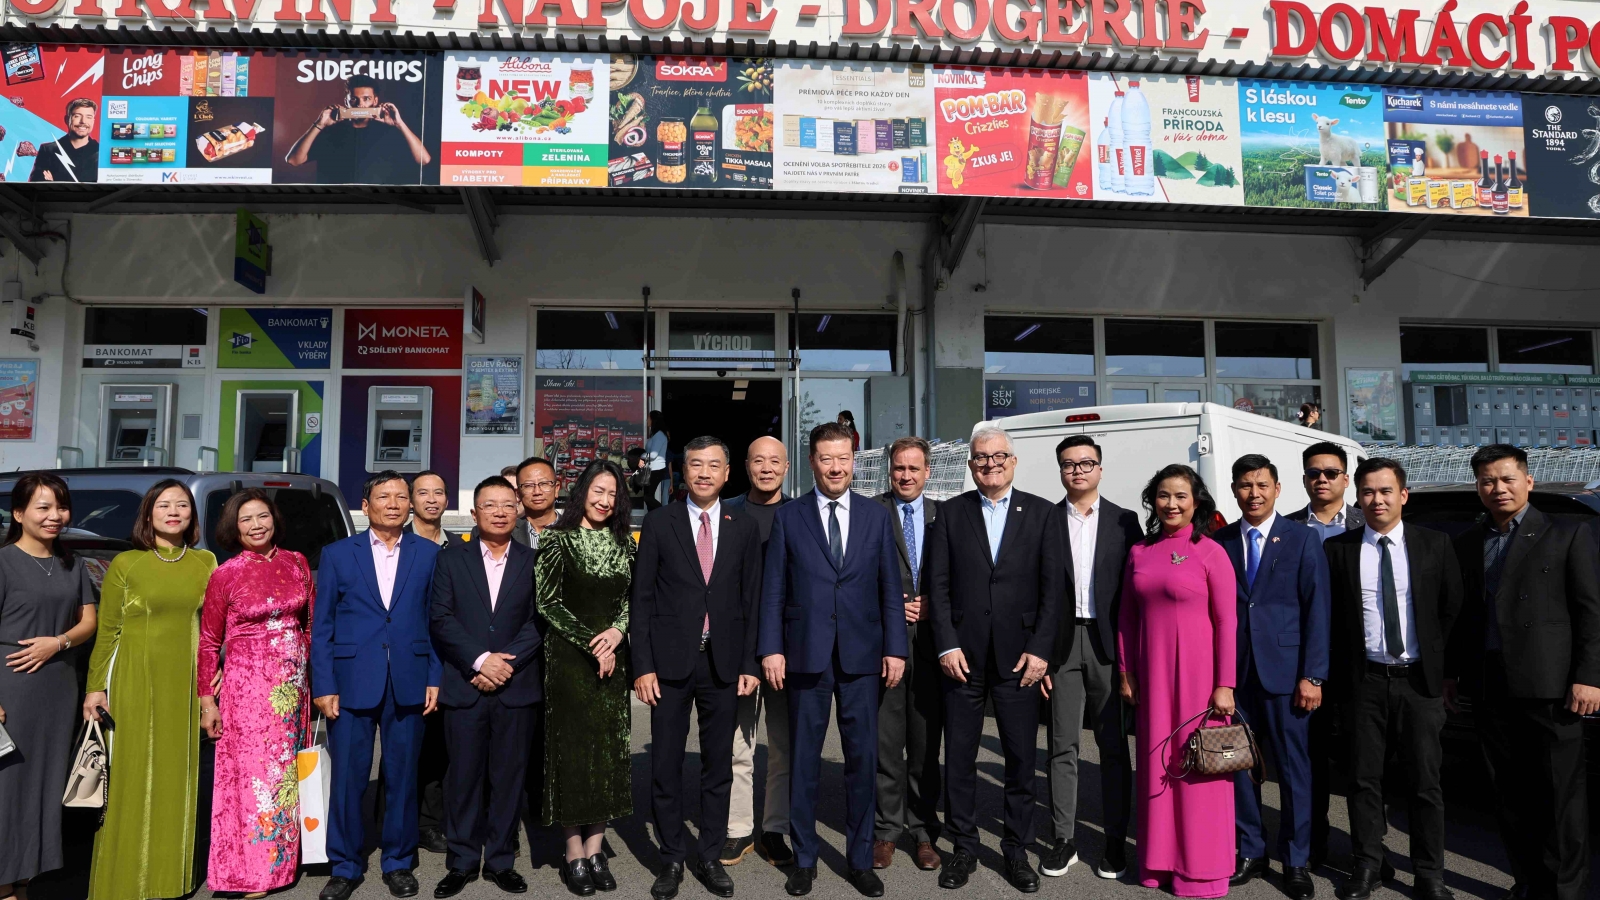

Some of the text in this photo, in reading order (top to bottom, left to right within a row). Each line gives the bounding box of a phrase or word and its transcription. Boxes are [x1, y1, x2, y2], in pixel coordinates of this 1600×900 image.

[841, 0, 1209, 50] DROGERIE
[1269, 0, 1535, 70] DOMÁCÍ
[1549, 16, 1600, 72] P
[123, 52, 163, 74] Long
[499, 56, 551, 71] Alibona
[296, 59, 423, 83] SIDECHIPS
[660, 65, 714, 76] SOKRA
[122, 69, 163, 89] Chips
[937, 74, 978, 85] NOVINKA
[489, 80, 561, 102] NEW
[798, 88, 834, 96] PRÉMIOVÁ
[870, 90, 895, 98] KAŽDÝ
[1189, 78, 1198, 98] Vittel
[1246, 89, 1317, 106] S láskou
[1344, 96, 1366, 105] Tento
[1387, 96, 1422, 107] Kucharek
[1430, 100, 1436, 108] S
[1437, 100, 1456, 109] námi
[1458, 101, 1497, 110] nesáhnete
[1162, 108, 1223, 117] FRANCOUZSKÁ
[1247, 108, 1296, 124] k lesu
[964, 118, 1009, 135] Crizzlies
[1163, 116, 1224, 132] PŘÍRODA
[1196, 129, 1228, 142] doma
[1532, 129, 1578, 139] STANDARD
[1546, 139, 1565, 147] 1894
[455, 150, 504, 158] KOMPOTY
[542, 154, 590, 162] ZELENINA
[1134, 148, 1142, 168] Vittel
[744, 159, 772, 168] MASALA
[971, 151, 1014, 168] ZKUS JE!
[831, 161, 871, 169] SPOTŘEBITELE
[162, 172, 178, 182] MK
[452, 175, 505, 183] DIABETIKY
[541, 177, 590, 185] PŘÍPRAVKY
[24, 321, 35, 331] KB
[268, 318, 319, 327] BANKOMAT
[382, 326, 449, 338] MONETA
[236, 336, 249, 346] Fio
[298, 341, 328, 349] VKLADY
[693, 332, 752, 350] VÝCHOD
[96, 348, 153, 356] BANKOMAT
[369, 345, 403, 354] SDÍLENÝ
[299, 350, 328, 360] VÝBĚRY
[496, 359, 518, 368] ŘADU
[992, 390, 1012, 398] SEN
[1029, 387, 1061, 395] KOREJSKÉ
[992, 398, 1012, 408] SOY
